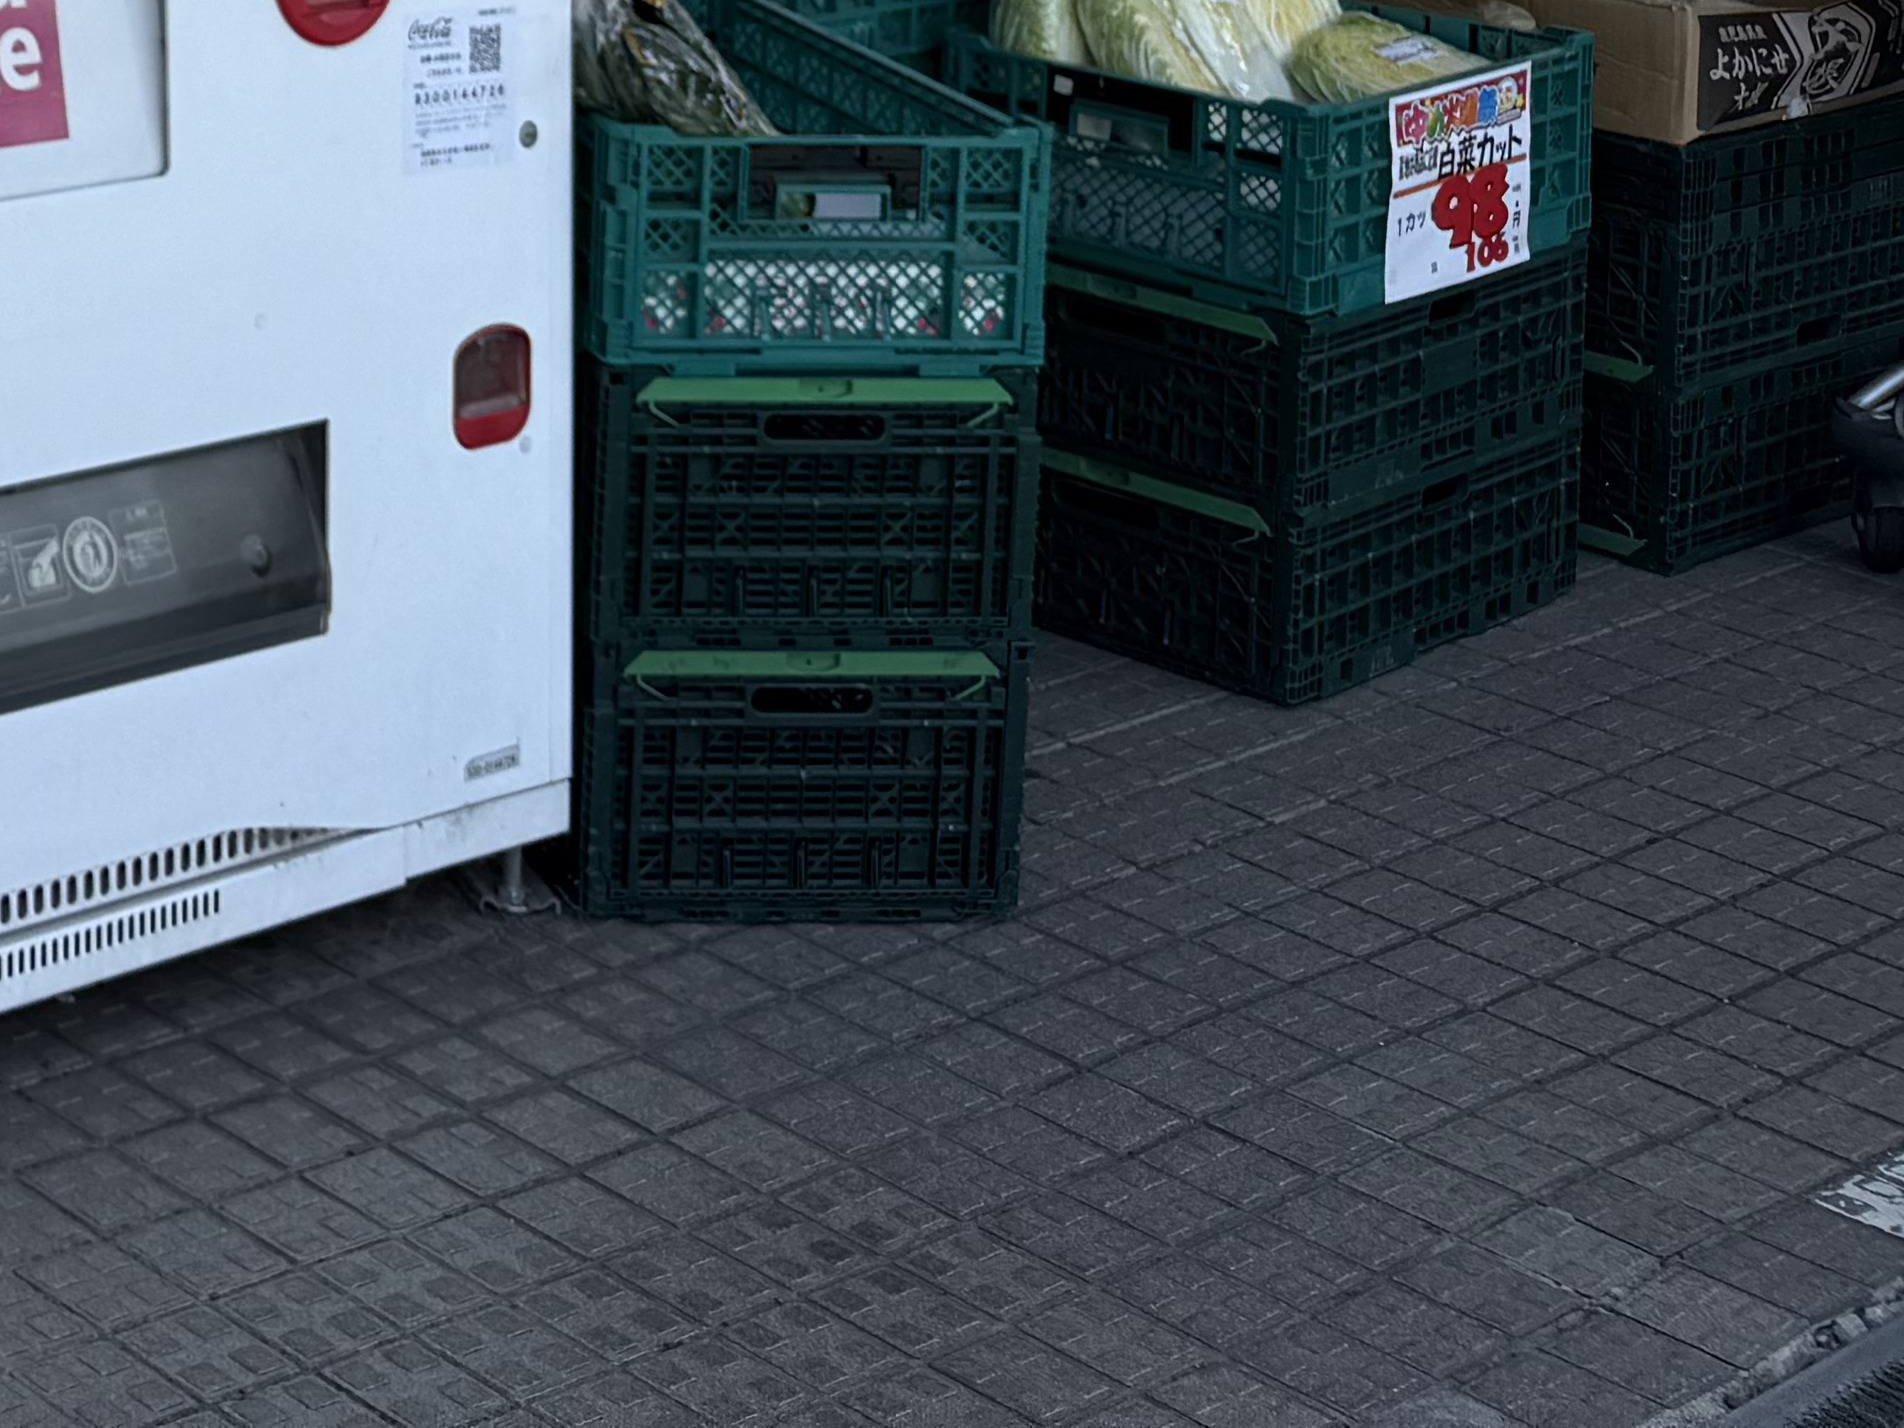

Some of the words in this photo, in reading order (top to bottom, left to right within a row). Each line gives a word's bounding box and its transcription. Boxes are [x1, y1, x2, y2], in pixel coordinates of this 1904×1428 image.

[1710, 43, 1790, 81] よかにせ
[1437, 123, 1523, 180] 白菜カット
[1430, 161, 1510, 250] 98
